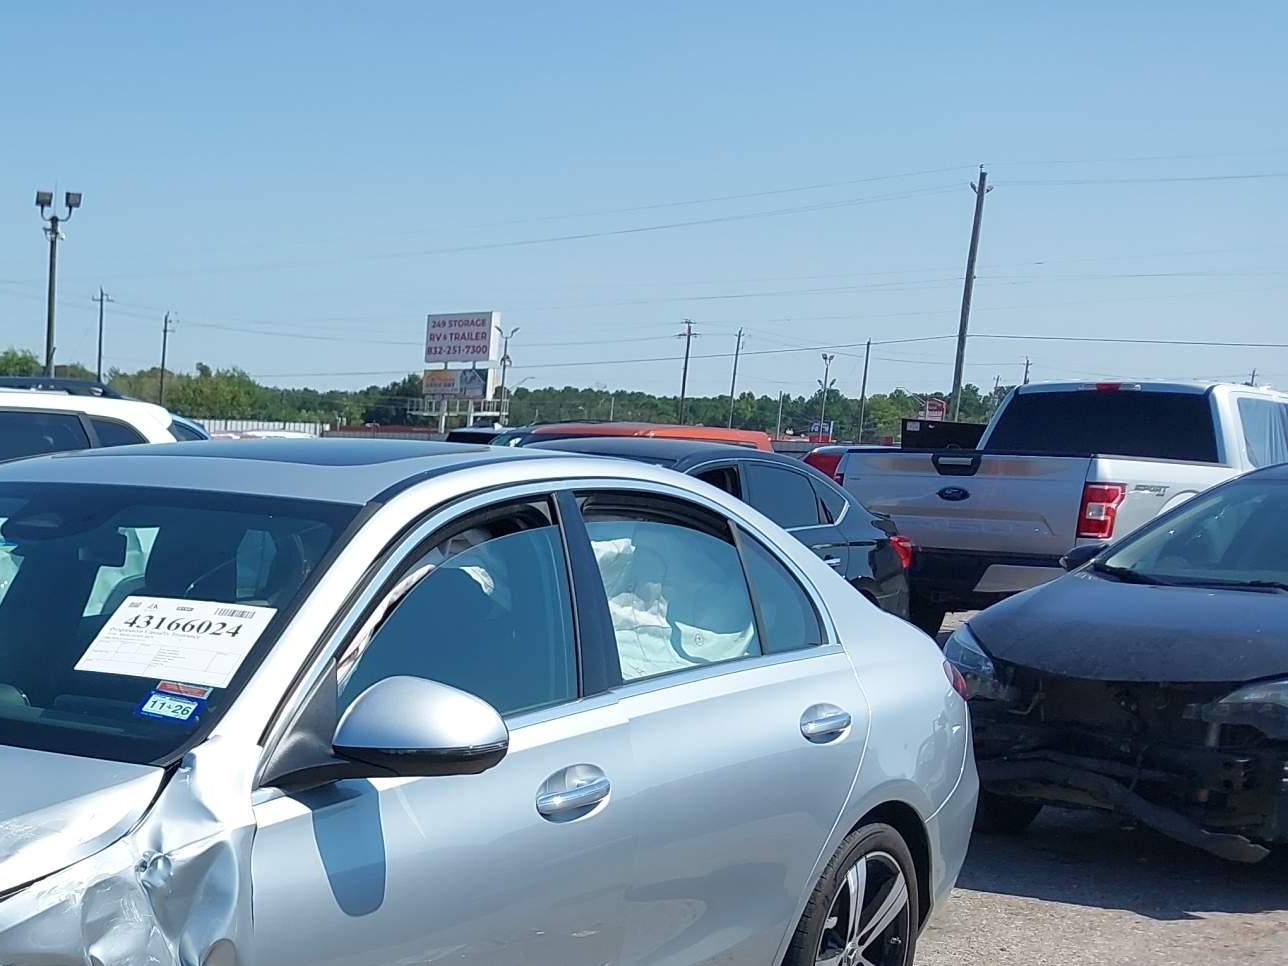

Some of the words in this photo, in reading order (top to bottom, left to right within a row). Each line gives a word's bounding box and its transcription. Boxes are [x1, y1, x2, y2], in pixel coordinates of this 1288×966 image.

[432, 320, 446, 328] 249
[448, 319, 486, 328] STORAGE
[450, 332, 487, 341] TRAILER
[124, 614, 243, 638] 43166024
[150, 700, 166, 711] 11
[172, 704, 192, 716] 26
